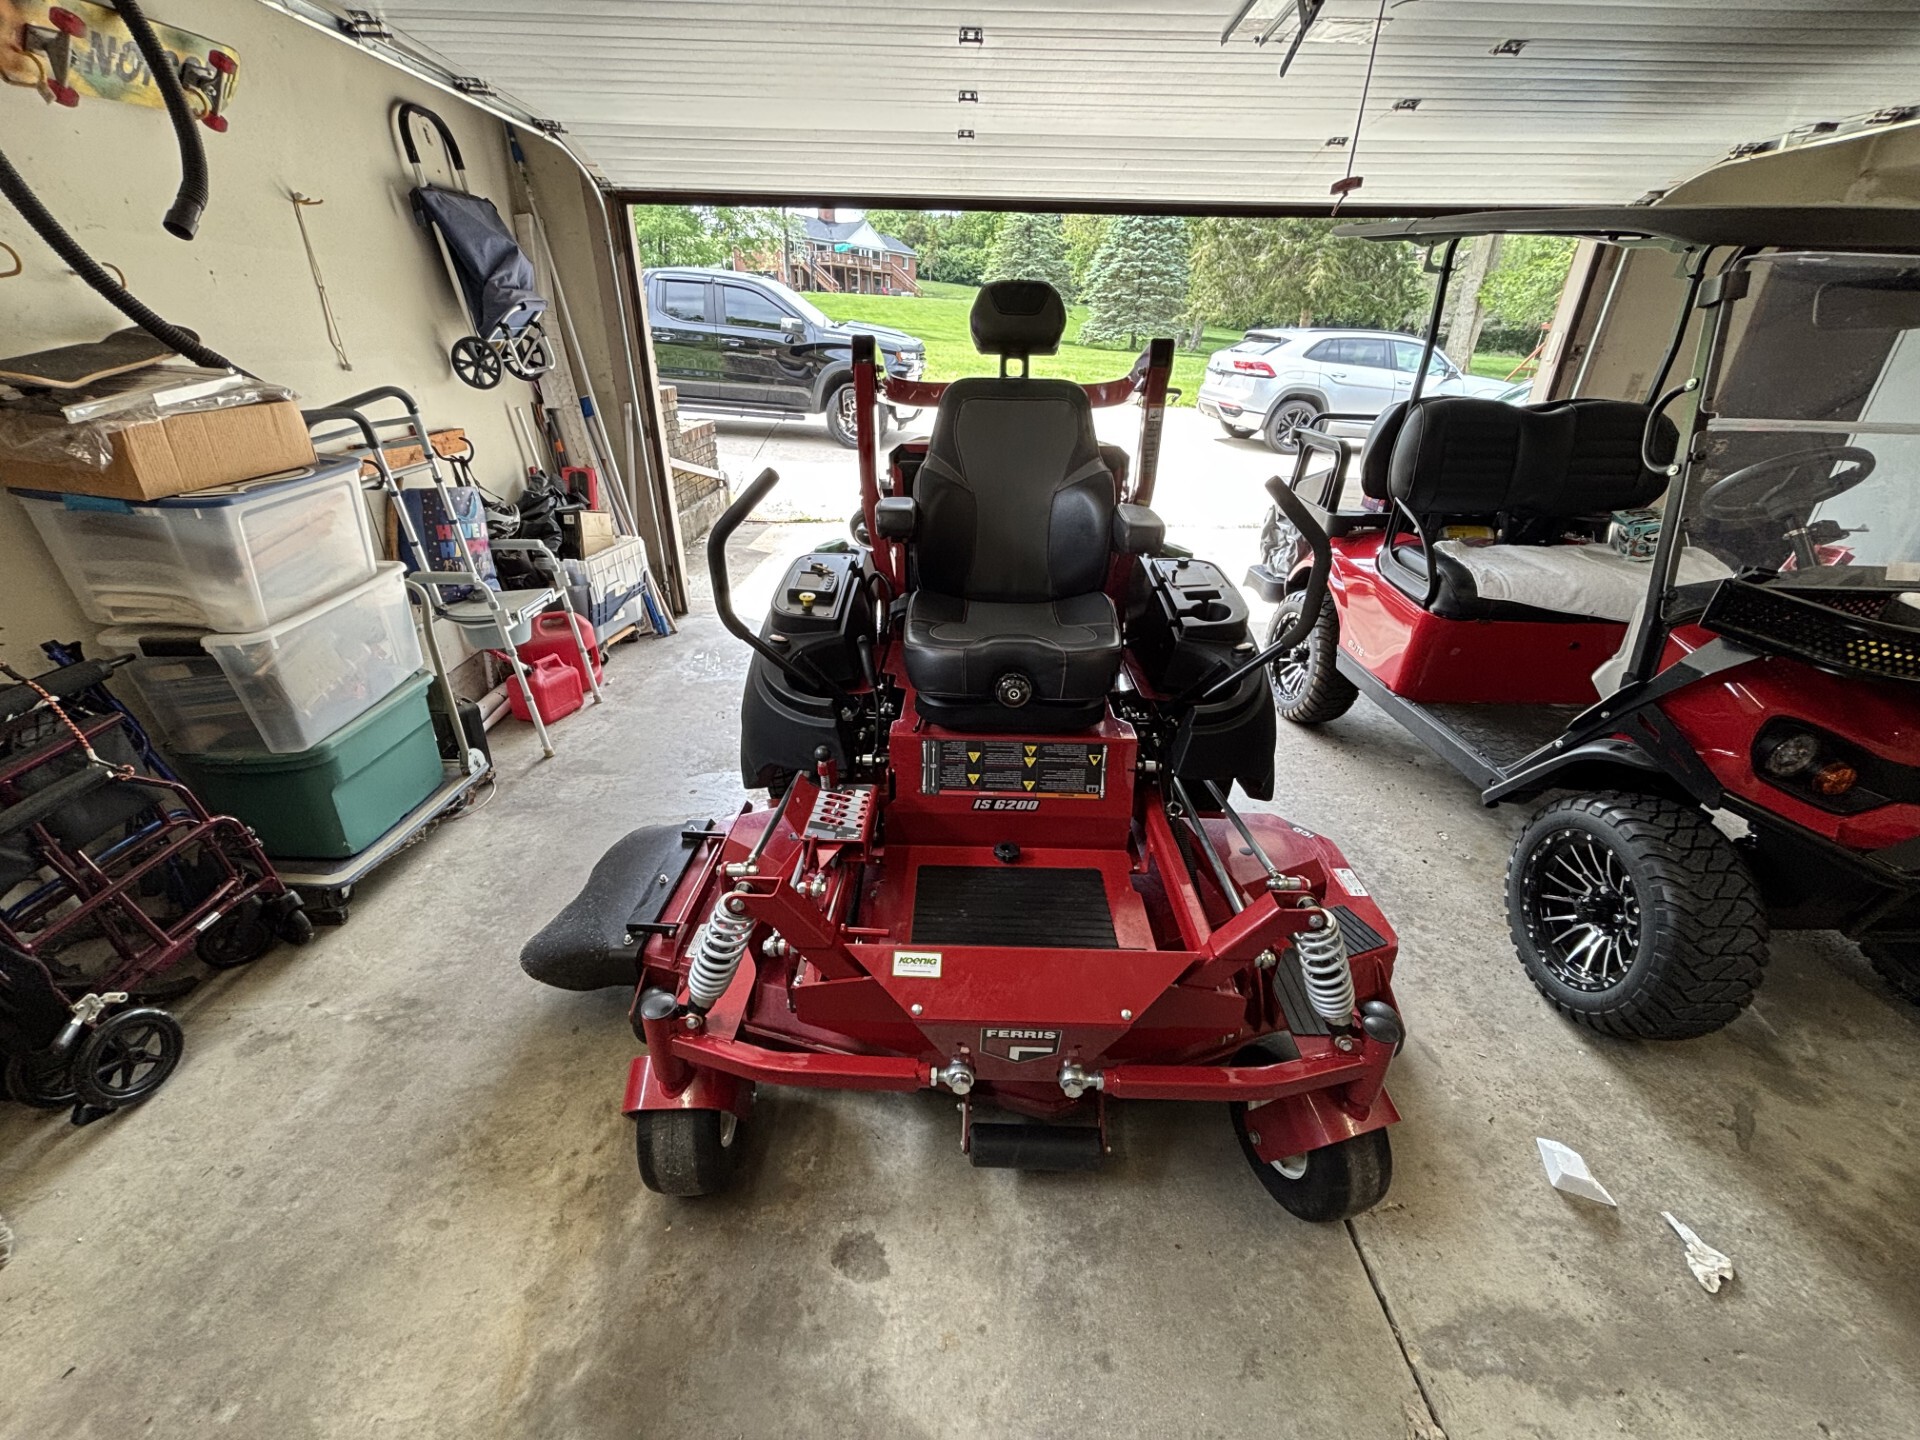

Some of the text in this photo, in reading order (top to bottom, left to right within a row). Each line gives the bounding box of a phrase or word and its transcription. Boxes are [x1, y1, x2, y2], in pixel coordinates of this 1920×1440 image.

[436, 523, 480, 539] HVE
[973, 799, 1039, 811] IS 6200
[986, 1029, 1057, 1040] FERRIS
